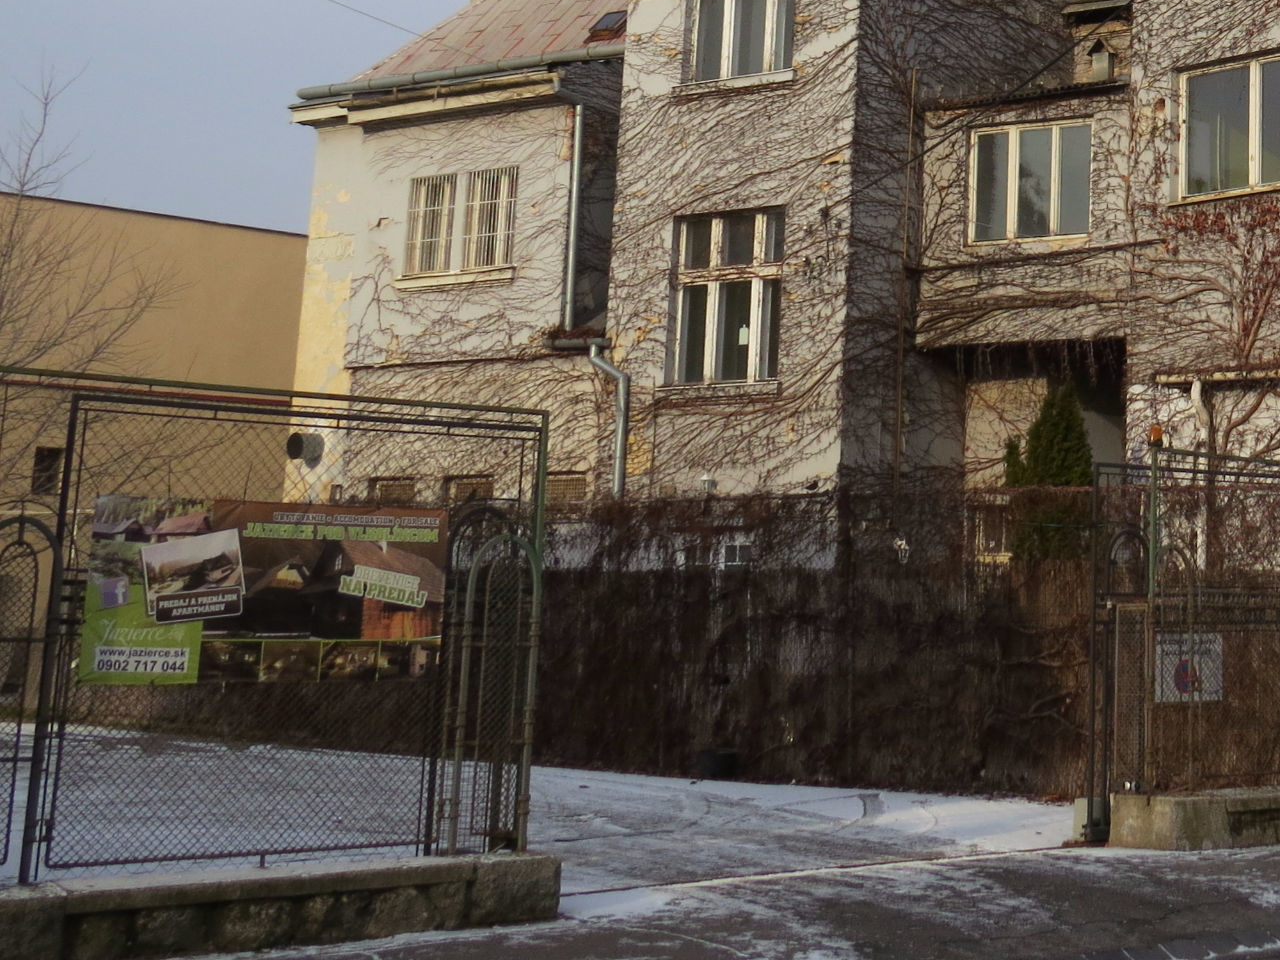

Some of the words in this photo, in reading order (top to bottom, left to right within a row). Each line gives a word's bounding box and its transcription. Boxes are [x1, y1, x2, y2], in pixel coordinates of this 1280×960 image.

[418, 517, 440, 527] SALE
[355, 566, 420, 590] DREVENICE
[340, 576, 363, 595] NA
[366, 582, 427, 607] PREDAJ
[158, 598, 189, 609] PREDAJ
[99, 648, 186, 659] www.jazierce.sk
[97, 659, 129, 671] 0902
[134, 660, 158, 671] 717
[161, 661, 185, 672] 044
